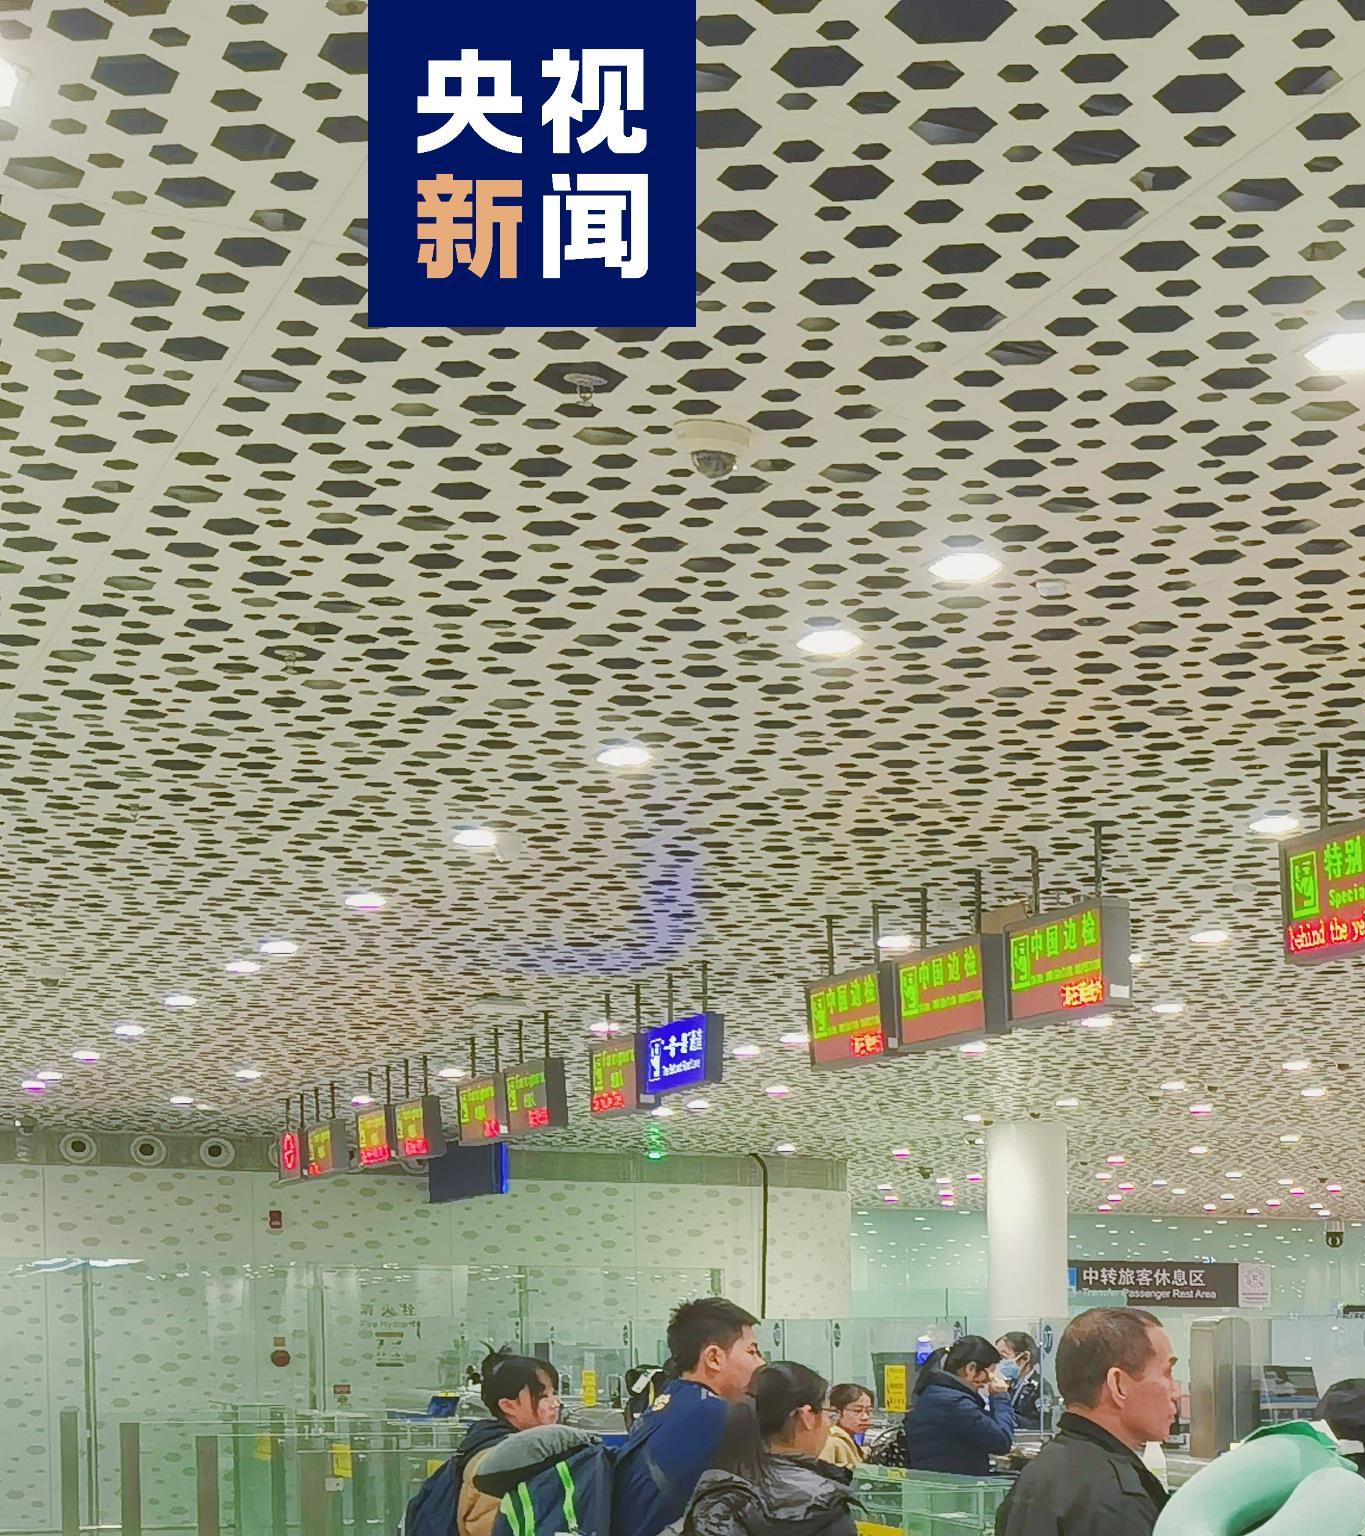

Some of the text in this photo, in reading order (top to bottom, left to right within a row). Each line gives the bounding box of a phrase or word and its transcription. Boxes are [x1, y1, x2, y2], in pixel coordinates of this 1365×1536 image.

[1031, 911, 1096, 960] 中国边检
[1329, 916, 1348, 942] the
[918, 945, 977, 990] 中国边检
[825, 974, 877, 1014] 中国边检
[1082, 1267, 1206, 1287] 中转旅客休息区
[1122, 1288, 1171, 1300] Passenger
[1172, 1289, 1194, 1299] Rest
[1195, 1290, 1217, 1299] Area
